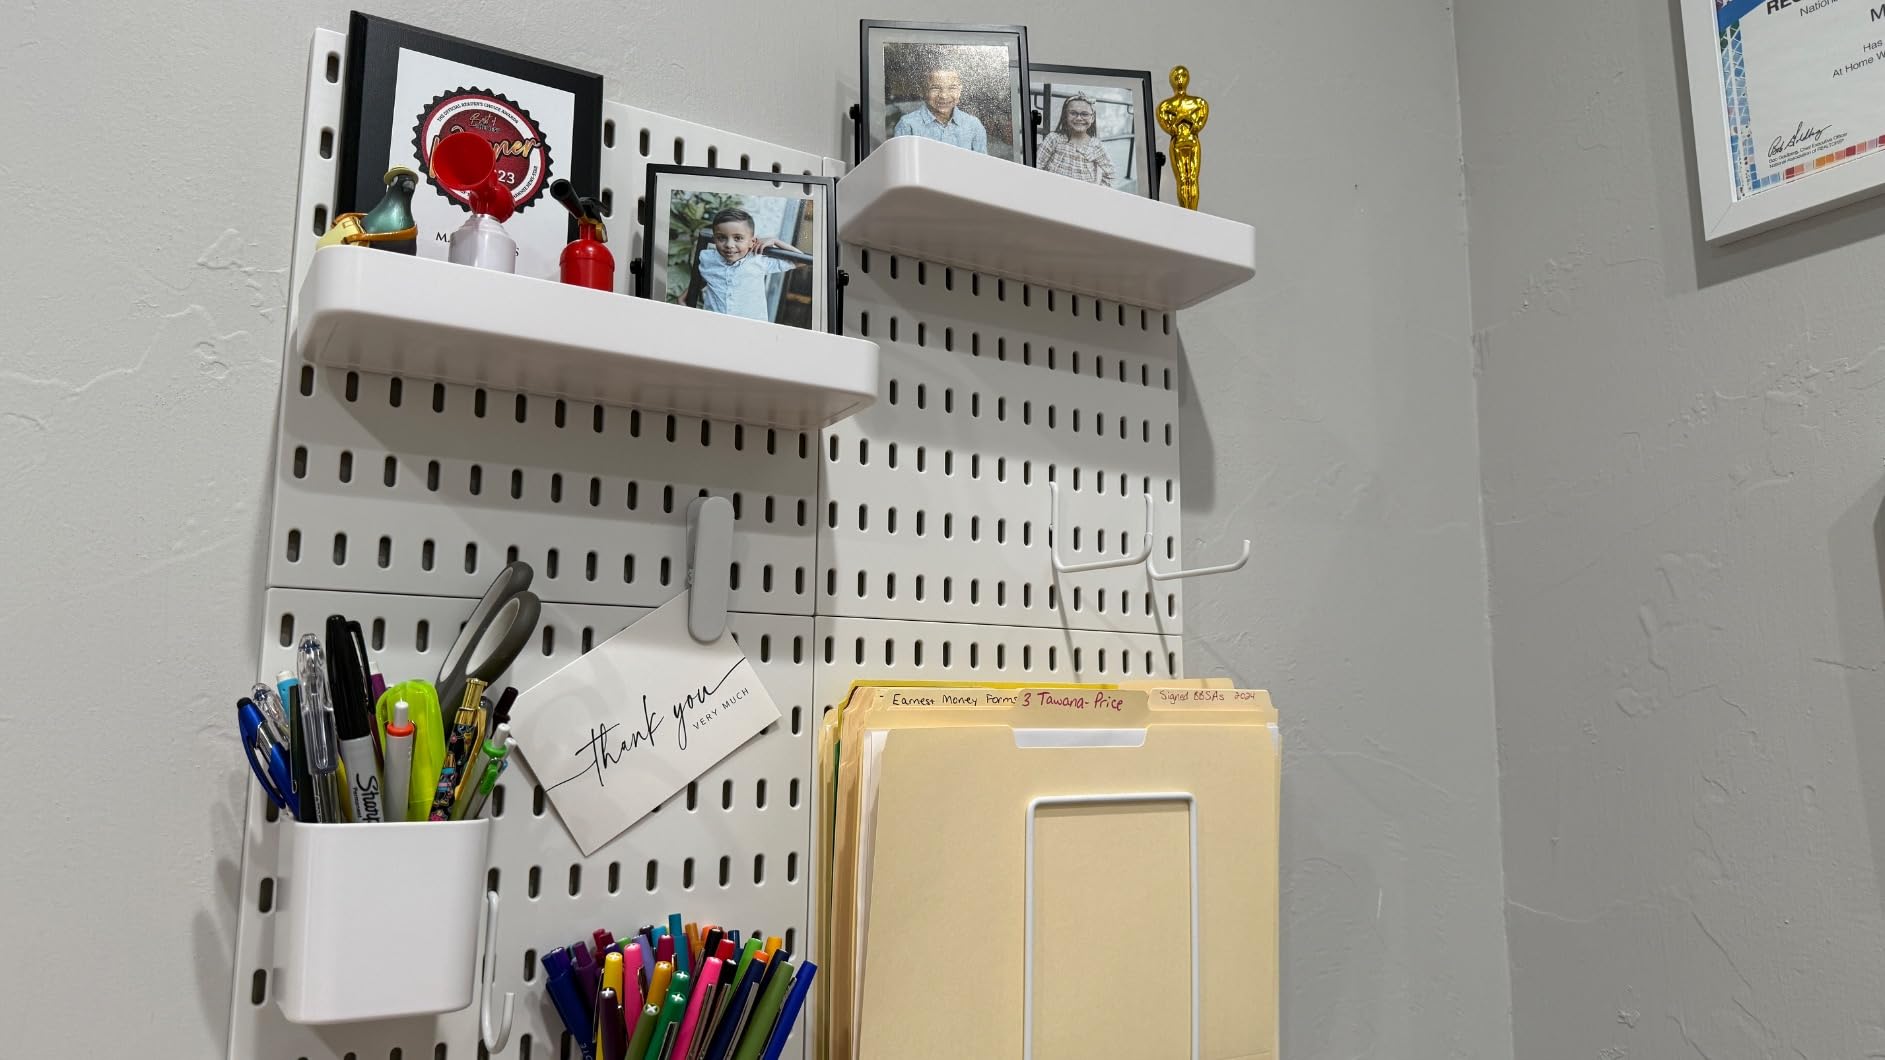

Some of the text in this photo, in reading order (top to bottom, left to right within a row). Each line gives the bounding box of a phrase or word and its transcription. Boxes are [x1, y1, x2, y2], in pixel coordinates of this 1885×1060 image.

[1767, 0, 1801, 15] RE
[1799, 0, 1839, 16] Nation
[1863, 39, 1883, 53] Has
[1832, 68, 1843, 78] At
[1845, 56, 1874, 73] Home
[892, 693, 936, 706] Earnest
[942, 694, 978, 706] Money
[1022, 693, 1031, 708] 3
[1159, 690, 1189, 704] Signed
[1234, 692, 1256, 701] 2024
[692, 687, 750, 731] VERY MUCH
[545, 695, 664, 792] thank
